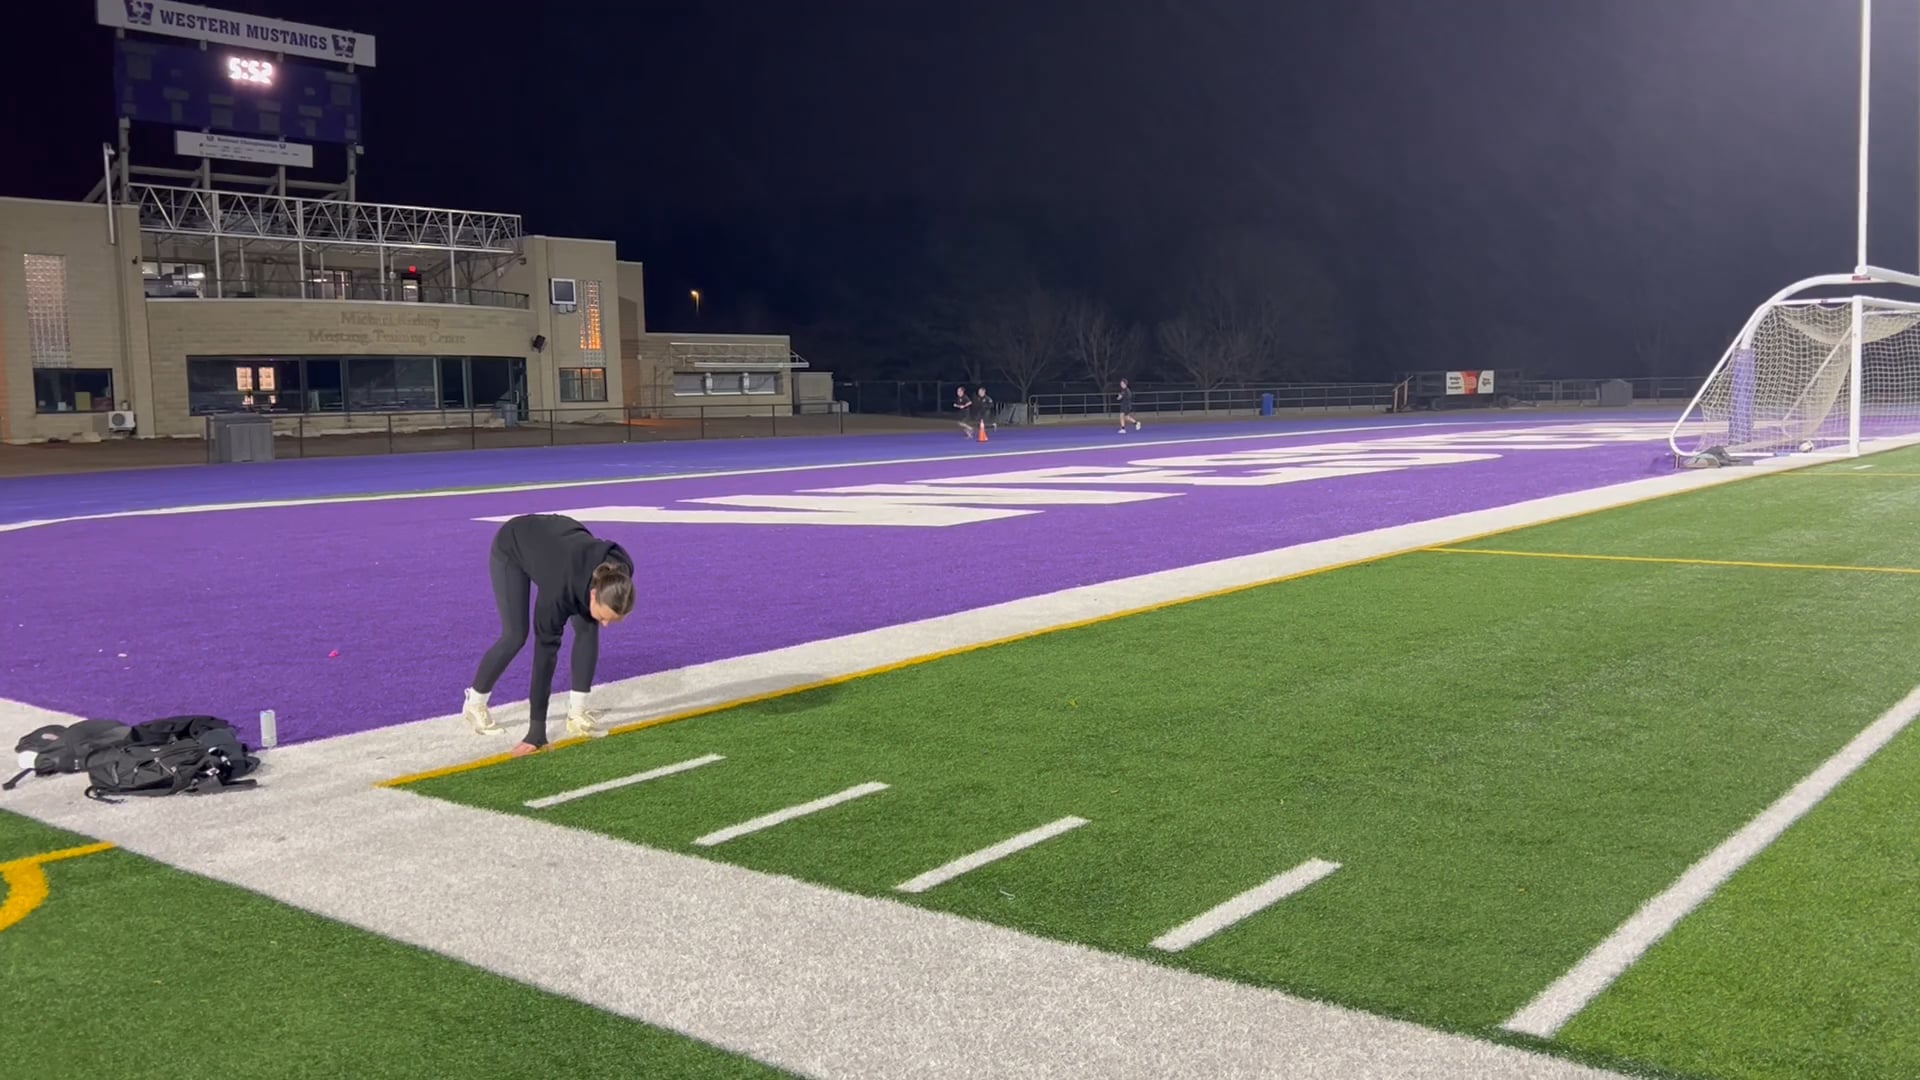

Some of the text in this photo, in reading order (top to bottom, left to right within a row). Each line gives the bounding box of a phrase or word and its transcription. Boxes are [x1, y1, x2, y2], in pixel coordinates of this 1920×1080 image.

[160, 10, 328, 50] WESTERN MUSTANGS
[228, 56, 273, 84] 5:52
[372, 329, 427, 346] Training
